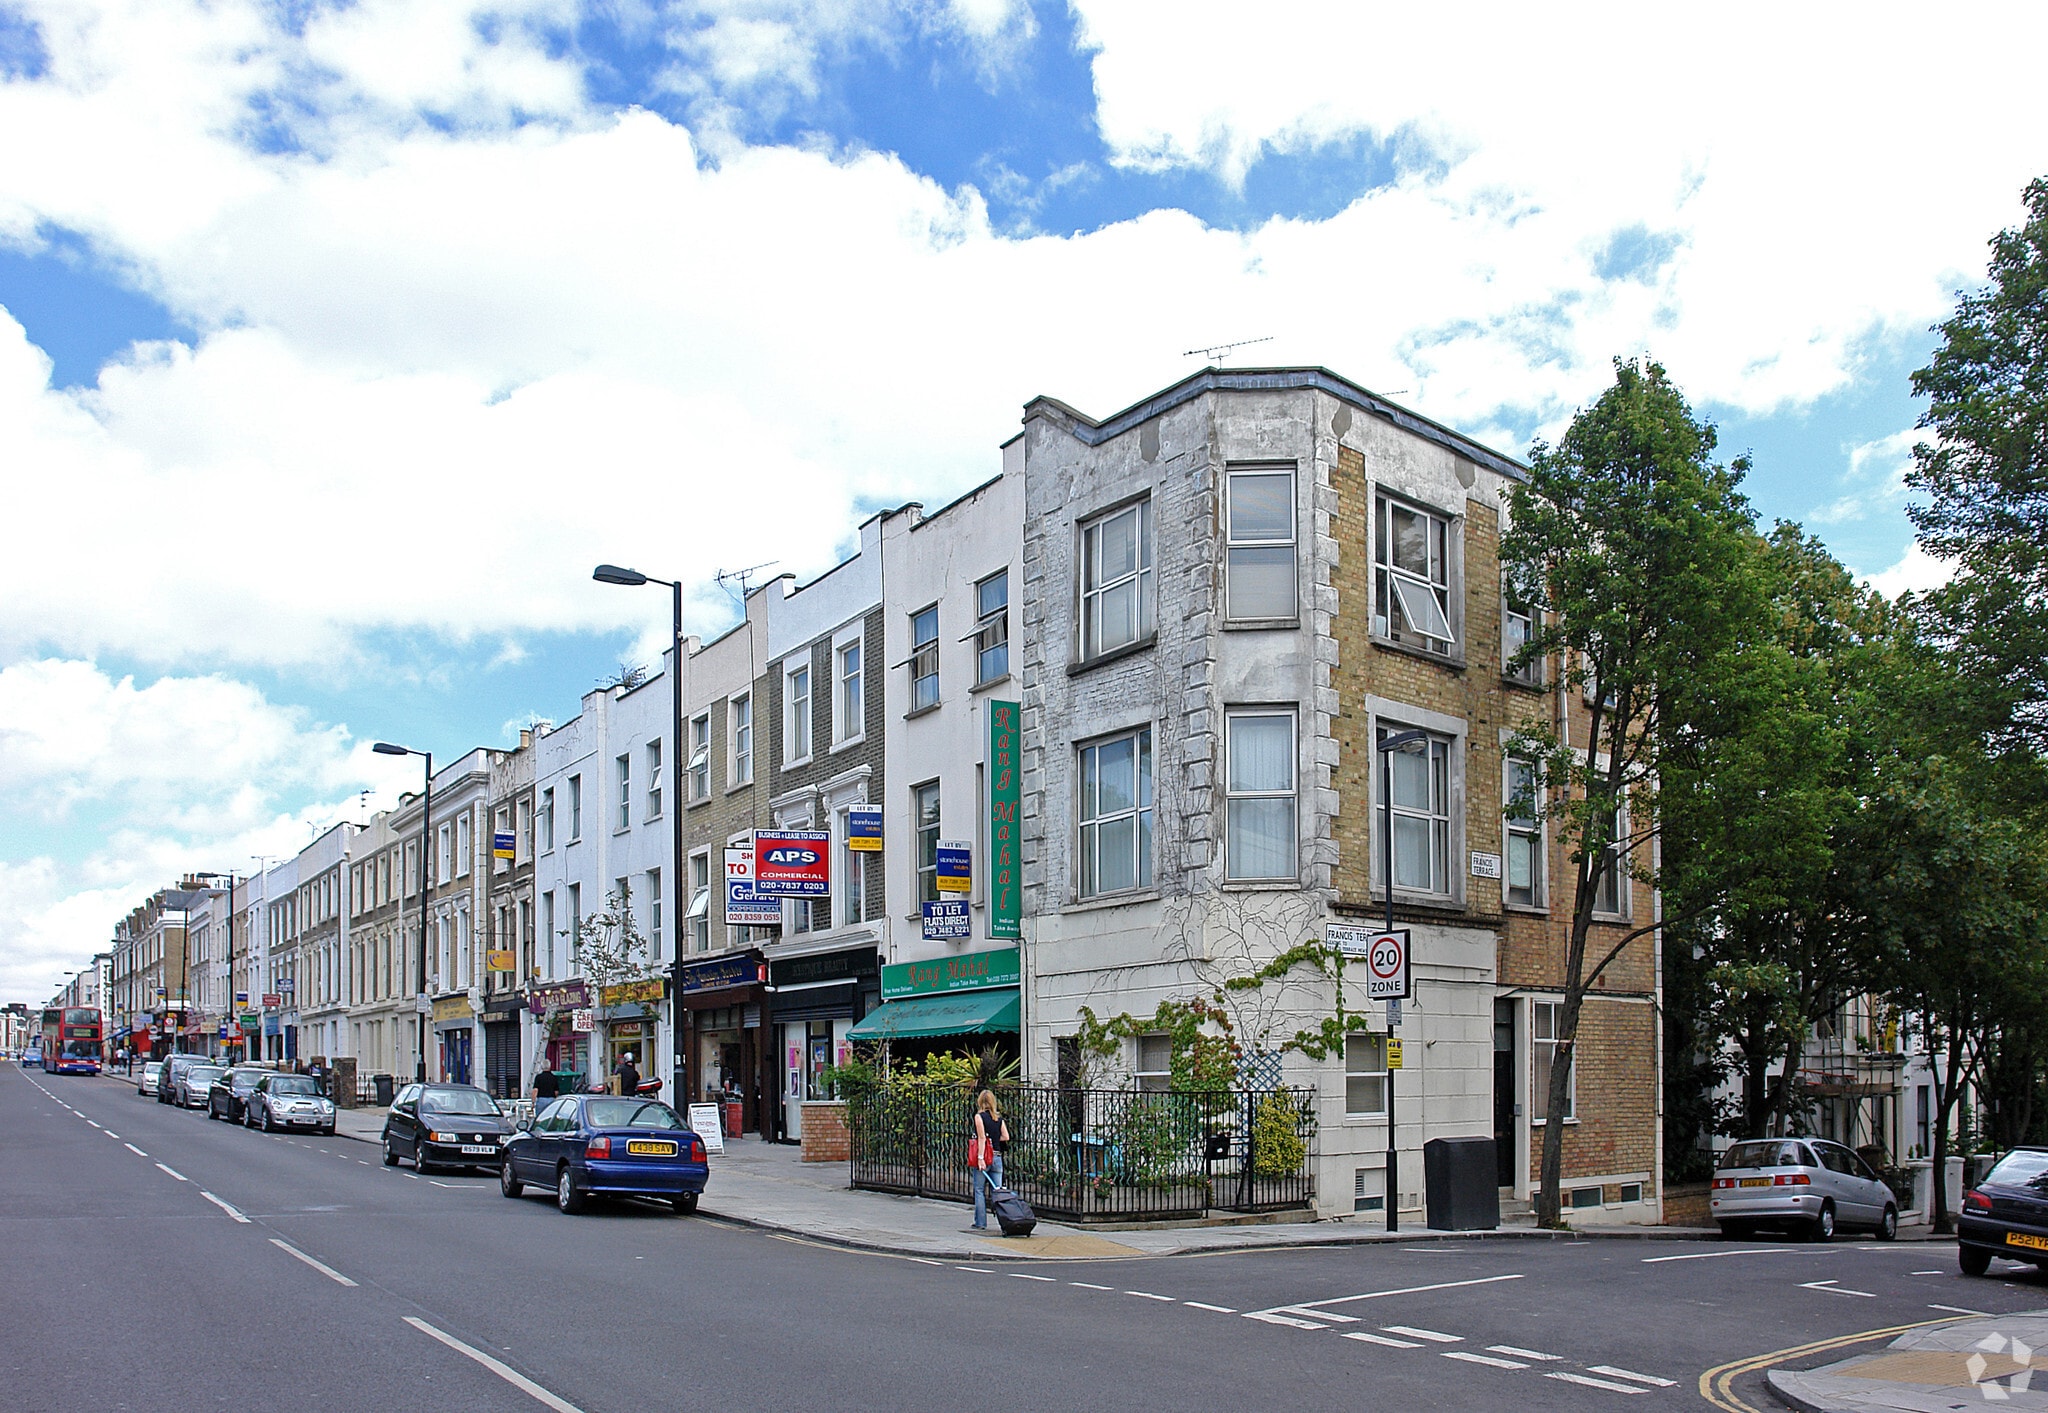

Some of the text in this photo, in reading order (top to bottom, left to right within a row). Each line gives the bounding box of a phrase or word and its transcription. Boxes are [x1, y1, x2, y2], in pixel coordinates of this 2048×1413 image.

[993, 707, 1018, 910] Rang Mahal
[851, 818, 881, 826] stonehouse
[758, 831, 780, 839] BUSINESS
[784, 832, 800, 840] LEASE
[741, 852, 753, 860] SH
[769, 850, 816, 863] APS
[939, 856, 969, 864] stonehouse
[1473, 857, 1493, 867] FRANCIS
[728, 863, 747, 875] TO
[1473, 865, 1494, 876] TERRACE
[760, 881, 802, 889] 020-7837
[931, 905, 962, 916] TO LET
[764, 913, 780, 921] 0515
[924, 915, 969, 927] FLATS DIRECT
[924, 927, 937, 935] 020
[1328, 930, 1367, 941] FRANCIS TER
[1375, 950, 1397, 966] 20
[908, 953, 990, 987] Rang Mahal
[1371, 980, 1401, 993] ZONE
[560, 991, 581, 1006] GLAZING
[577, 1021, 595, 1029] OPEN
[632, 1143, 654, 1152] T438
[654, 1143, 672, 1153] SAV
[2010, 1233, 2035, 1246] P521
